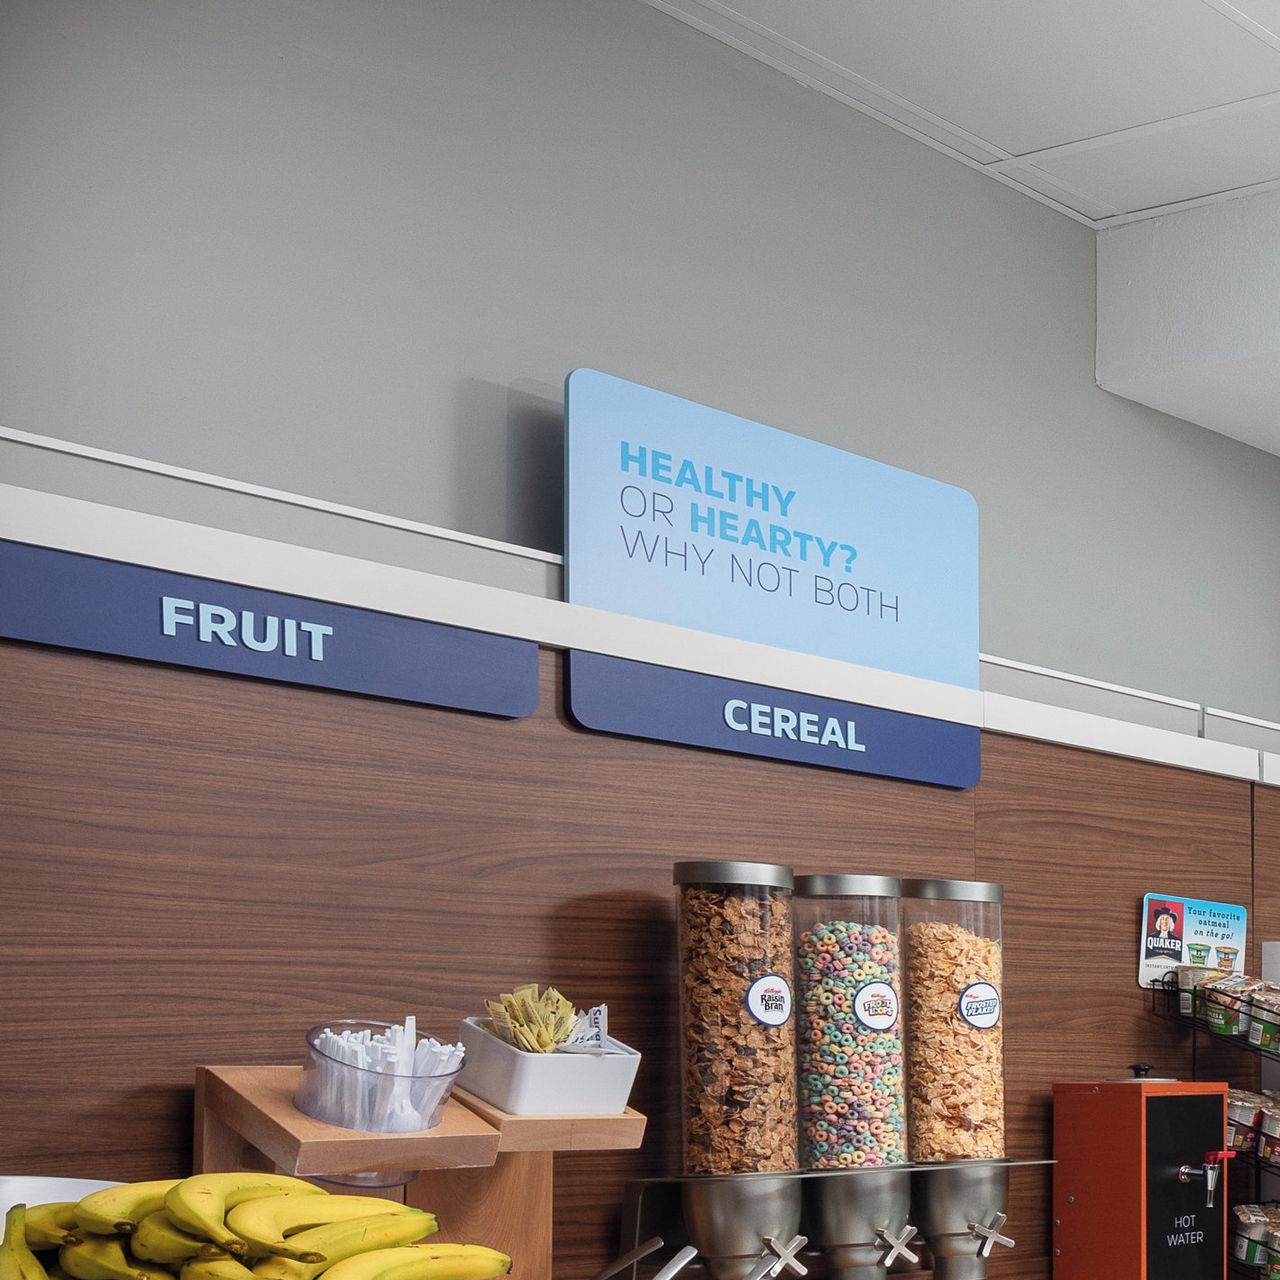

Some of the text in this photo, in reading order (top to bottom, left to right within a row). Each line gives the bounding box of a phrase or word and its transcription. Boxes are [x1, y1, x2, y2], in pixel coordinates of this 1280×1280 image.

[620, 440, 796, 517] HEALTHY
[620, 485, 858, 573] OR HEARTY?
[620, 525, 899, 623] WHY NOT BOTH
[162, 596, 334, 661] FRUIT
[724, 699, 866, 752] CEREAL
[1187, 906, 1240, 921] Your favorite
[1198, 919, 1229, 929] oatmeal
[1206, 930, 1219, 938] the
[1220, 932, 1234, 940] go!
[1147, 936, 1182, 951] QUAKER
[760, 993, 785, 1004] Raisin
[764, 1002, 784, 1012] Bran
[1174, 1214, 1196, 1228] HOT
[1167, 1231, 1204, 1247] WATER
